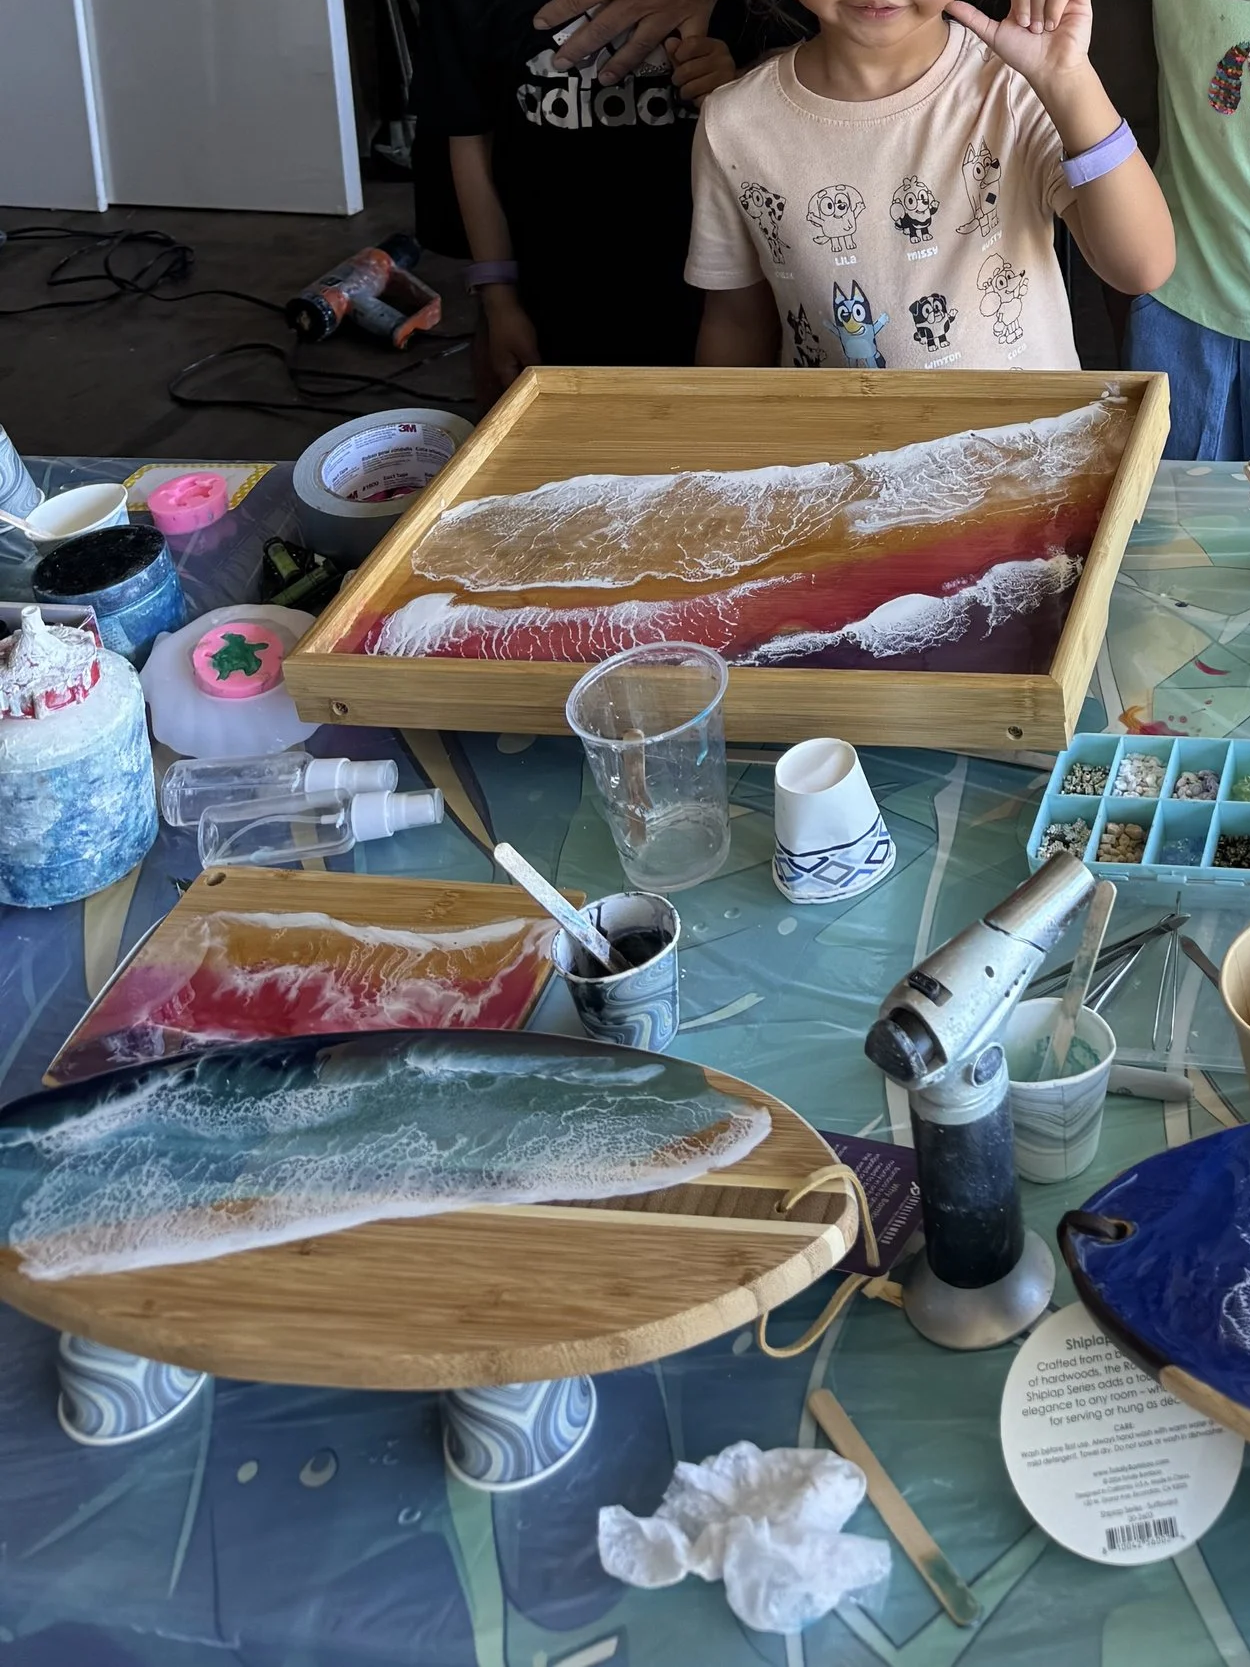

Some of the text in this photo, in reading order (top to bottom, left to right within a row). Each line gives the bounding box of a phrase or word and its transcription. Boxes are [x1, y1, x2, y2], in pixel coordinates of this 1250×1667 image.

[516, 74, 699, 130] adida
[398, 424, 417, 433] 3M
[1036, 1357, 1077, 1372] Crafted
[1079, 1352, 1103, 1364] from
[1105, 1352, 1112, 1361] a
[1026, 1387, 1064, 1402] Shiplap
[1067, 1381, 1096, 1395] Series
[1097, 1376, 1124, 1388] adds
[1126, 1376, 1134, 1385] a
[1028, 1378, 1039, 1388] of
[1042, 1367, 1101, 1385] hardwoods,
[1104, 1364, 1121, 1374] the
[1022, 1401, 1073, 1417] elegance
[1075, 1397, 1086, 1408] to
[1088, 1394, 1108, 1406] any
[1110, 1389, 1138, 1401] room
[1049, 1416, 1063, 1426] for
[1066, 1409, 1103, 1424] serving
[1105, 1408, 1114, 1417] or
[1117, 1402, 1144, 1416] hung
[1146, 1400, 1158, 1409] as
